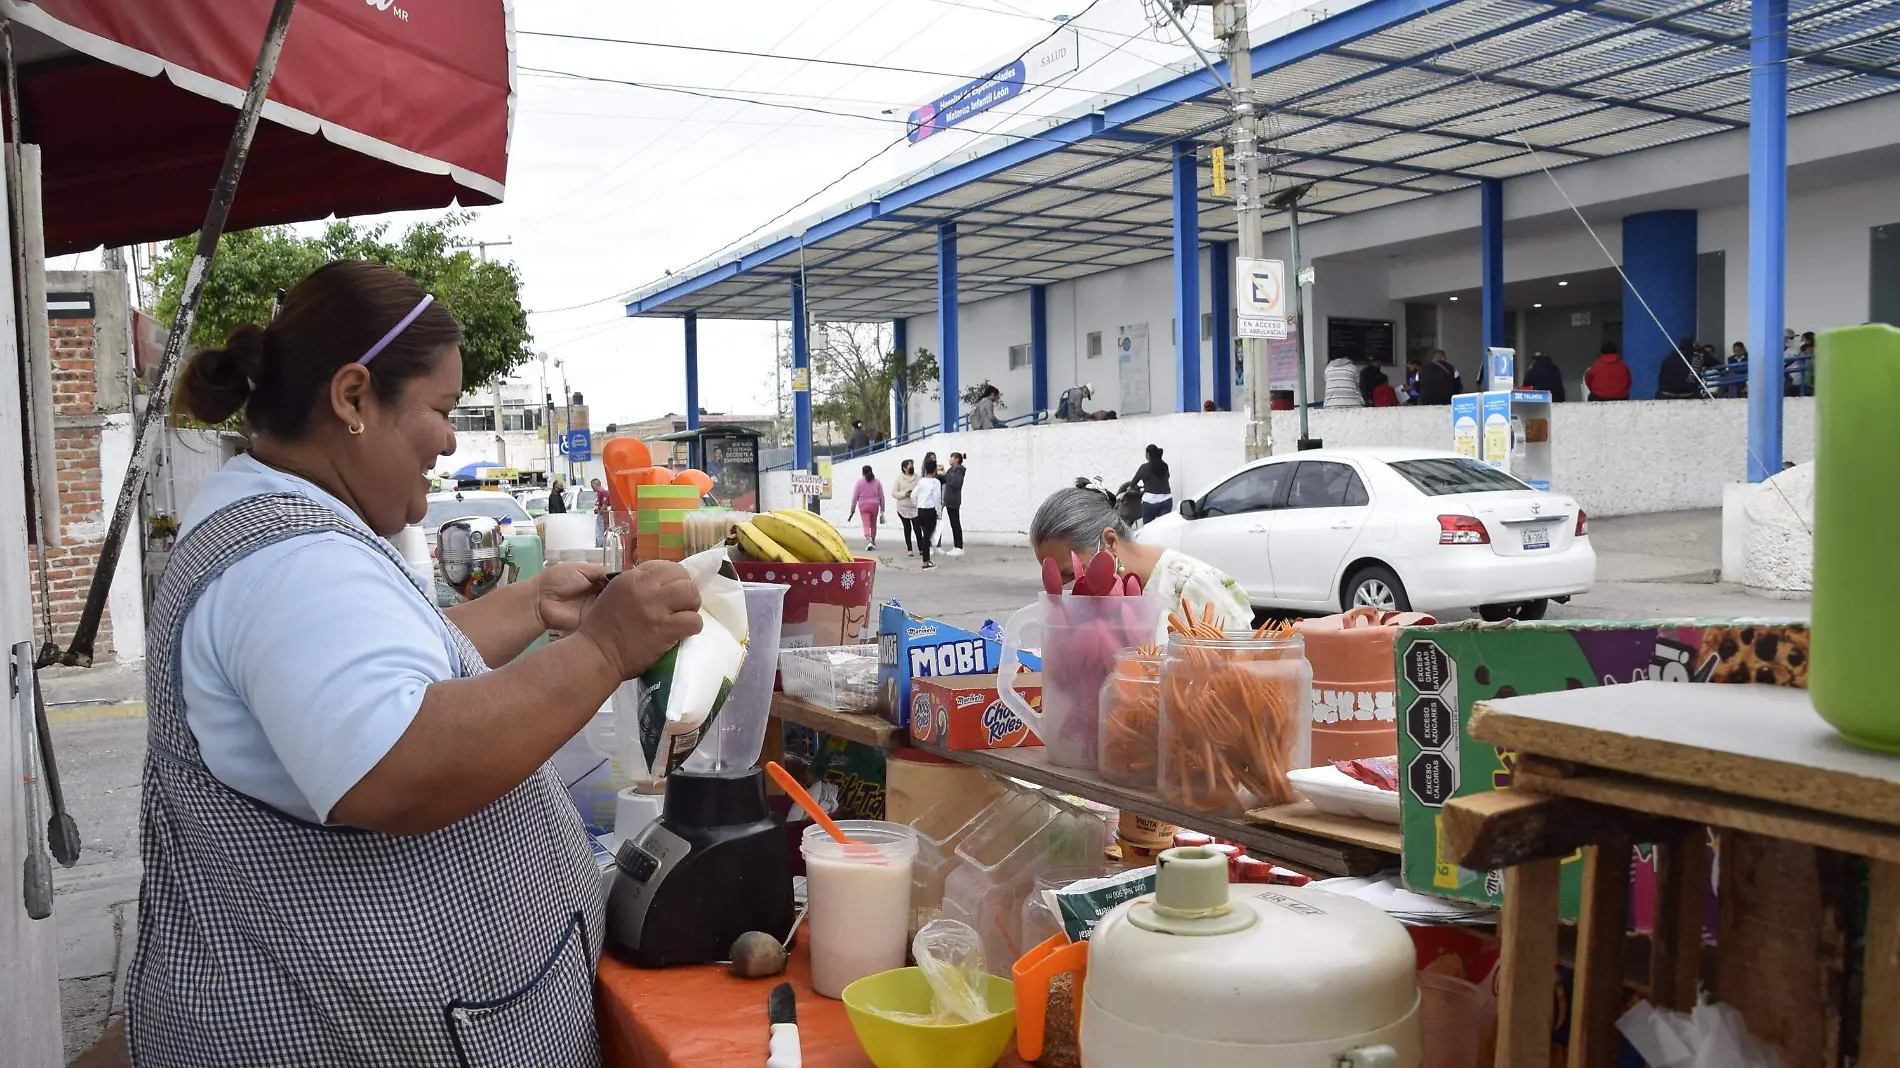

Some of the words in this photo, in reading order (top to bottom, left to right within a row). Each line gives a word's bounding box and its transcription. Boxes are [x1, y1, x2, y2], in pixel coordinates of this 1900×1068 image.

[393, 5, 409, 22] MR
[1041, 49, 1067, 67] SALUD
[946, 106, 970, 123] Materno
[970, 93, 993, 112] Infantil
[993, 85, 1009, 102] León
[1243, 320, 1253, 328] EN
[1255, 321, 1281, 330] ACCESO
[1249, 328, 1285, 336] AMBULANCIAS
[791, 474, 823, 484] EXCLUSIVO
[792, 484, 820, 494] TAXIS
[1416, 651, 1425, 682] EXCESO
[1423, 651, 1432, 683] GRASAS
[1428, 644, 1440, 690] SATURADAS
[984, 702, 1016, 726] Cho
[1423, 707, 1431, 739] EXCESO
[988, 717, 1023, 744] Roles
[1425, 763, 1433, 795] EXCESO
[1136, 817, 1157, 829] FRUTA
